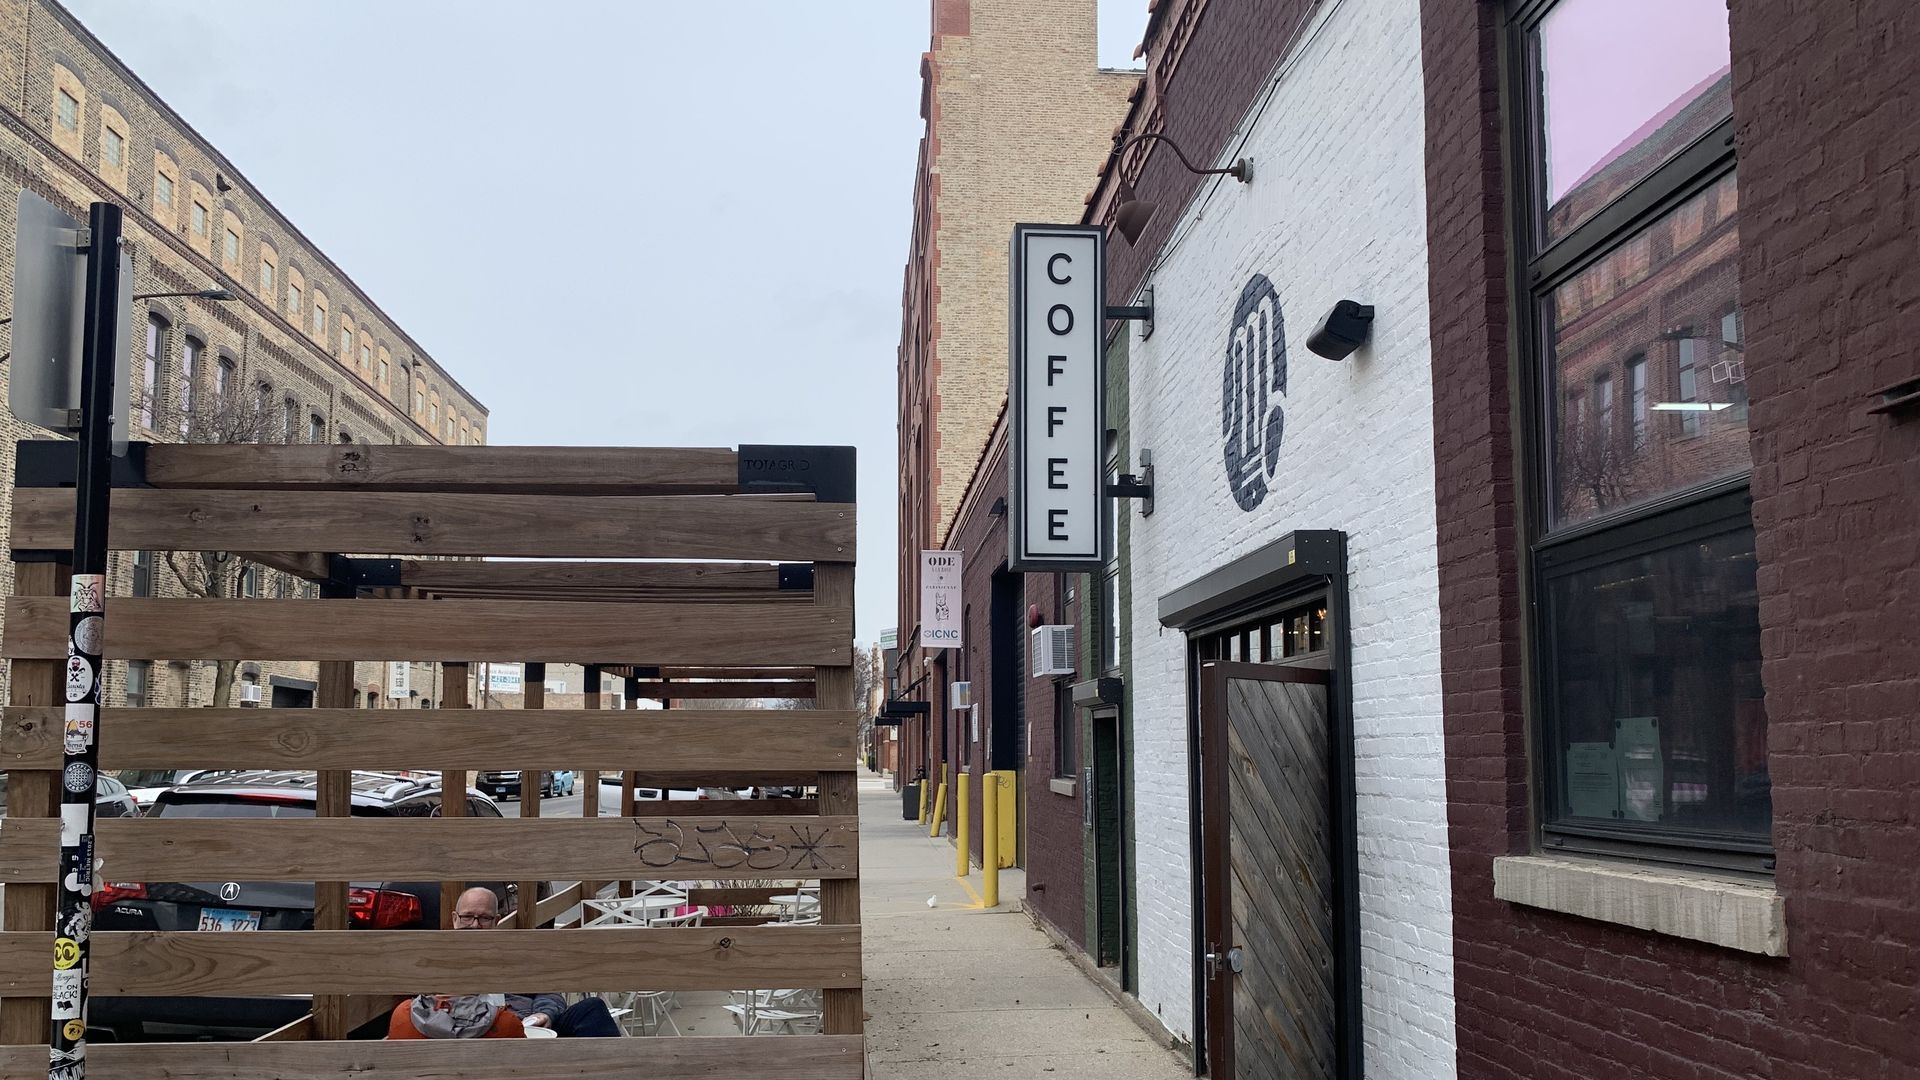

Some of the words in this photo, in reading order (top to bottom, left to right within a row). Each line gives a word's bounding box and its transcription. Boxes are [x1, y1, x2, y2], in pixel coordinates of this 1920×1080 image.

[1046, 252, 1075, 541] COFFEE
[928, 556, 955, 566] ODE
[932, 630, 959, 639] ICNC
[114, 906, 143, 917] ACURA
[200, 916, 223, 931] 536
